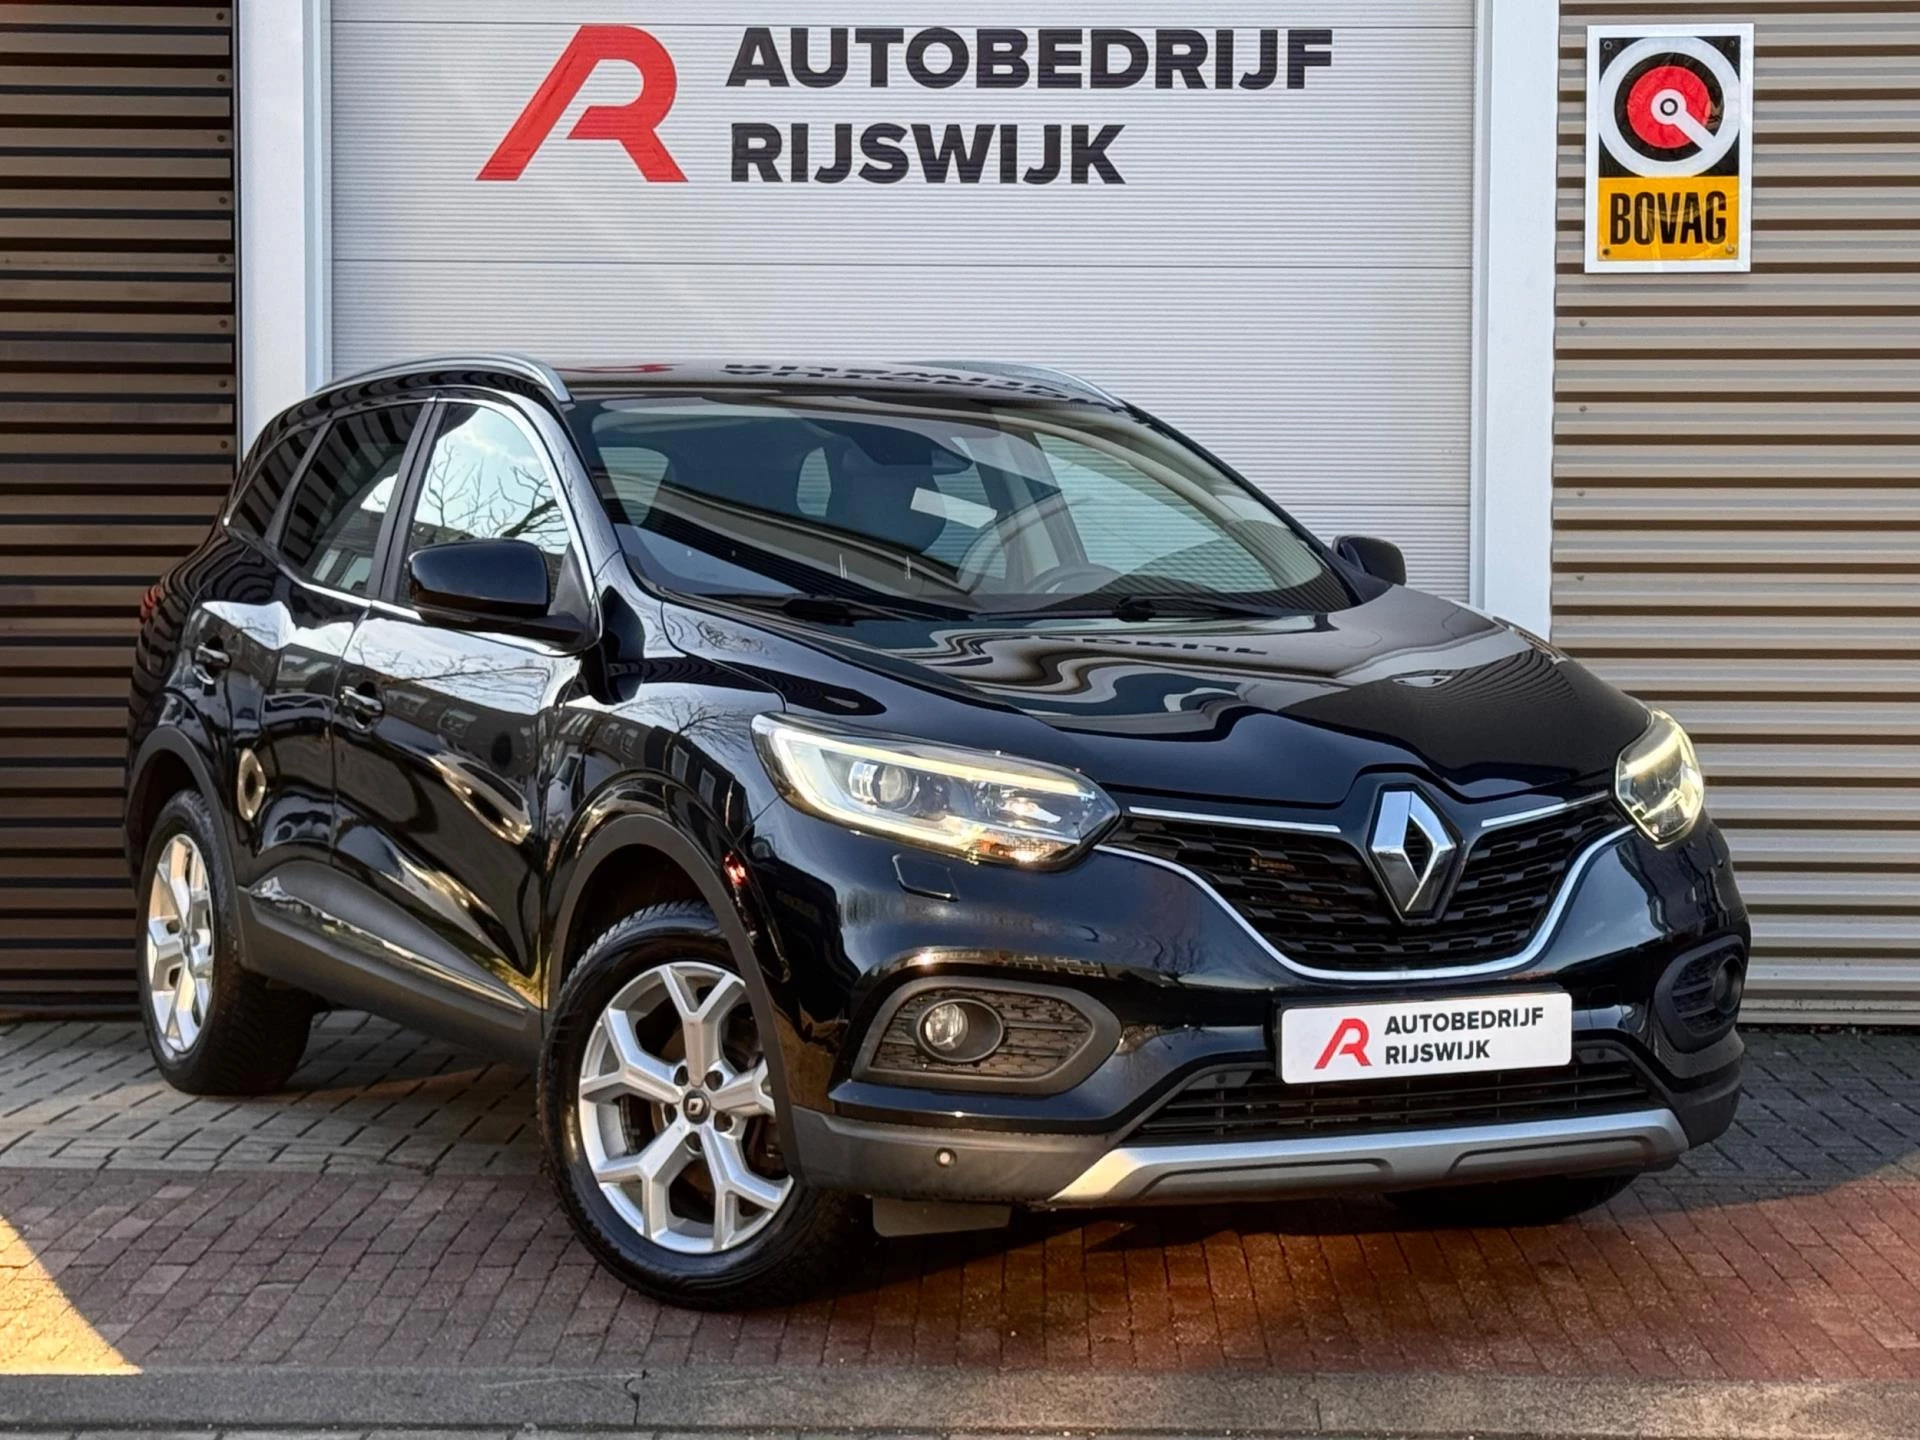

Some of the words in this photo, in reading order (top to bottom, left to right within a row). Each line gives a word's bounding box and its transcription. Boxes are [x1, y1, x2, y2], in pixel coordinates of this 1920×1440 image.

[726, 27, 1333, 90] AUTOBEDRIJF
[731, 123, 1126, 185] RIJSWIJK
[1610, 191, 1727, 245] BOVAG
[1384, 1007, 1544, 1036] AUTOBEDRIJF
[1385, 1039, 1491, 1065] RIJSWIJK
